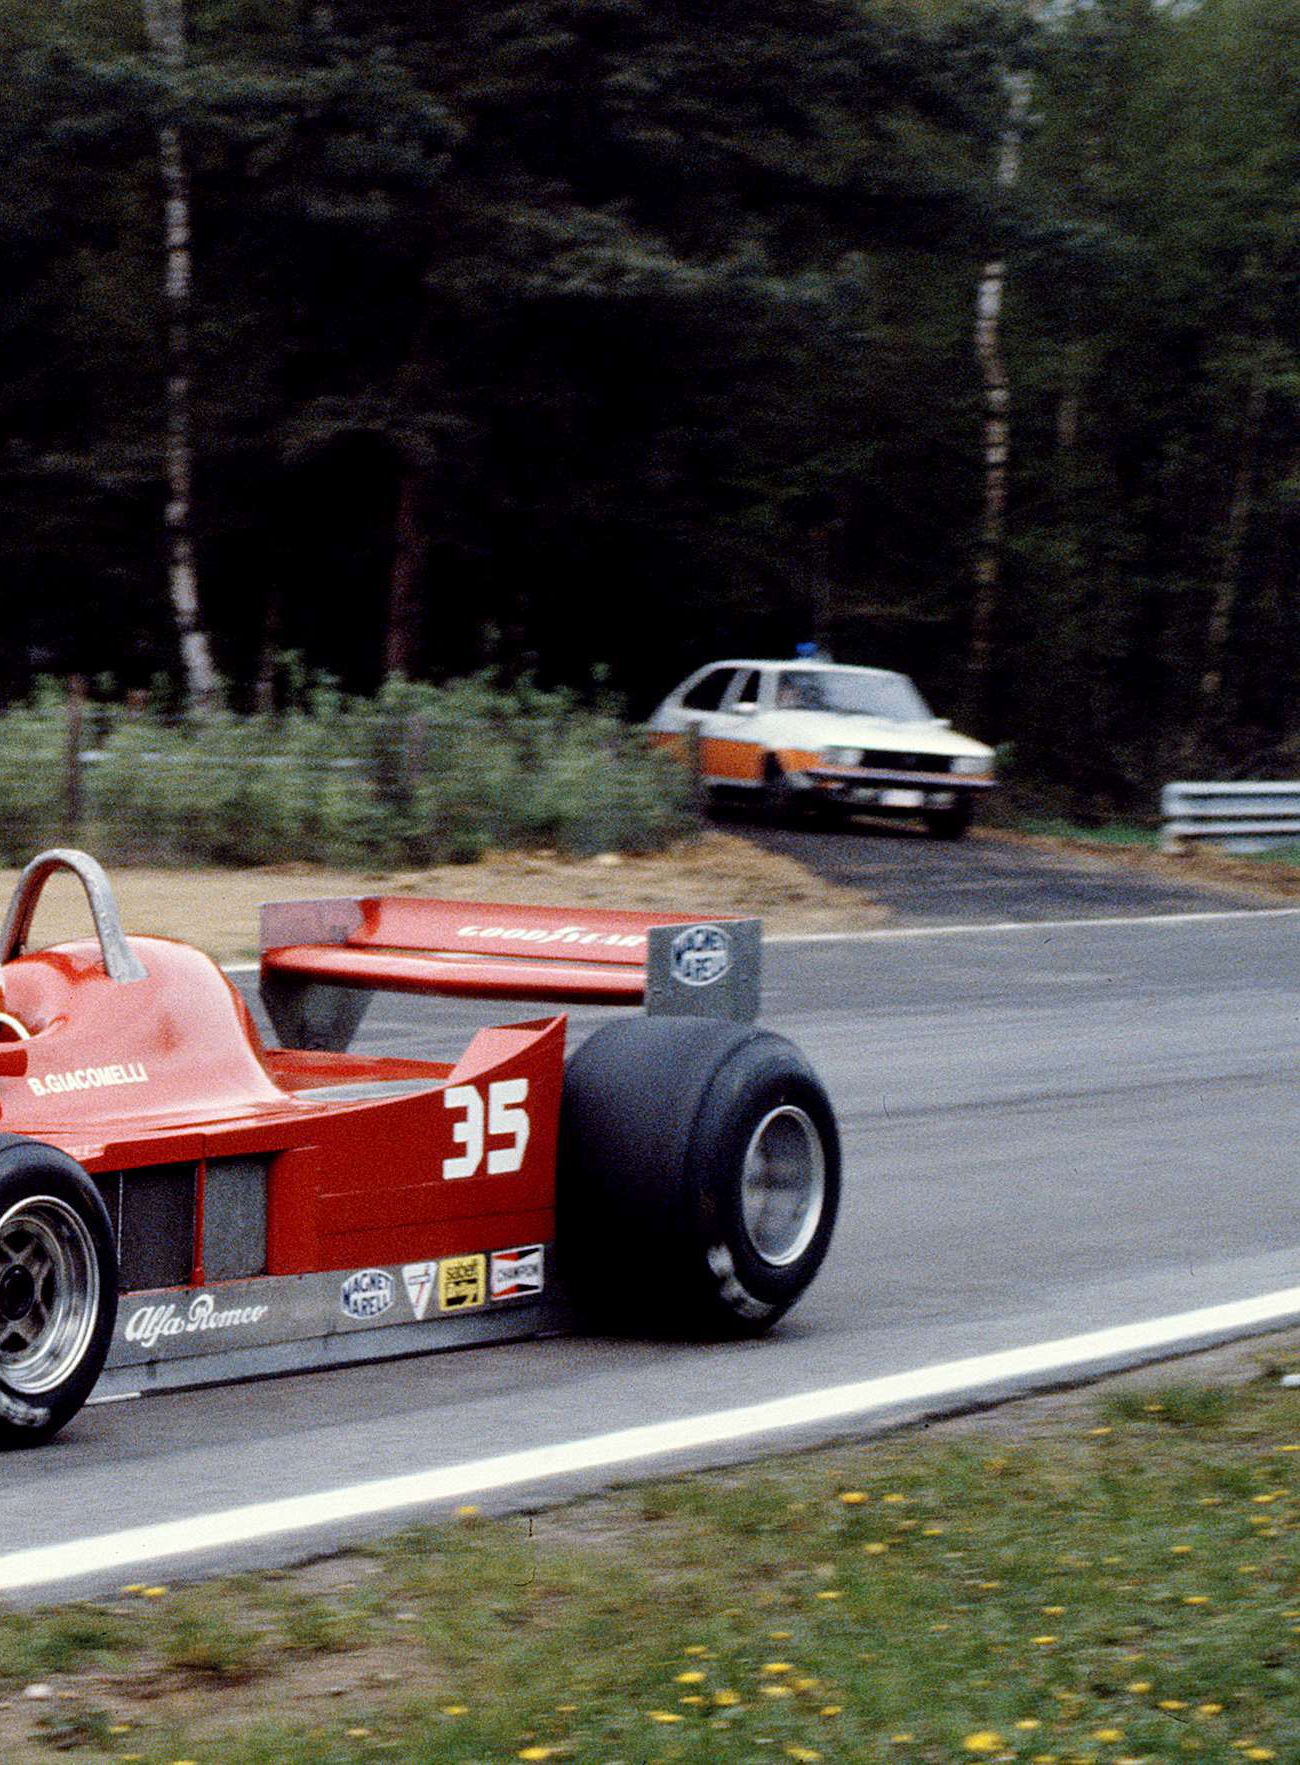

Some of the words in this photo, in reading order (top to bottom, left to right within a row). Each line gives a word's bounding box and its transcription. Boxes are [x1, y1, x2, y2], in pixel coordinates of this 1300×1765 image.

[27, 1062, 149, 1096] B.GIACOMELLI
[442, 1078, 530, 1180] 35
[124, 1303, 185, 1348] Alfa
[186, 1293, 269, 1332] Romeo
